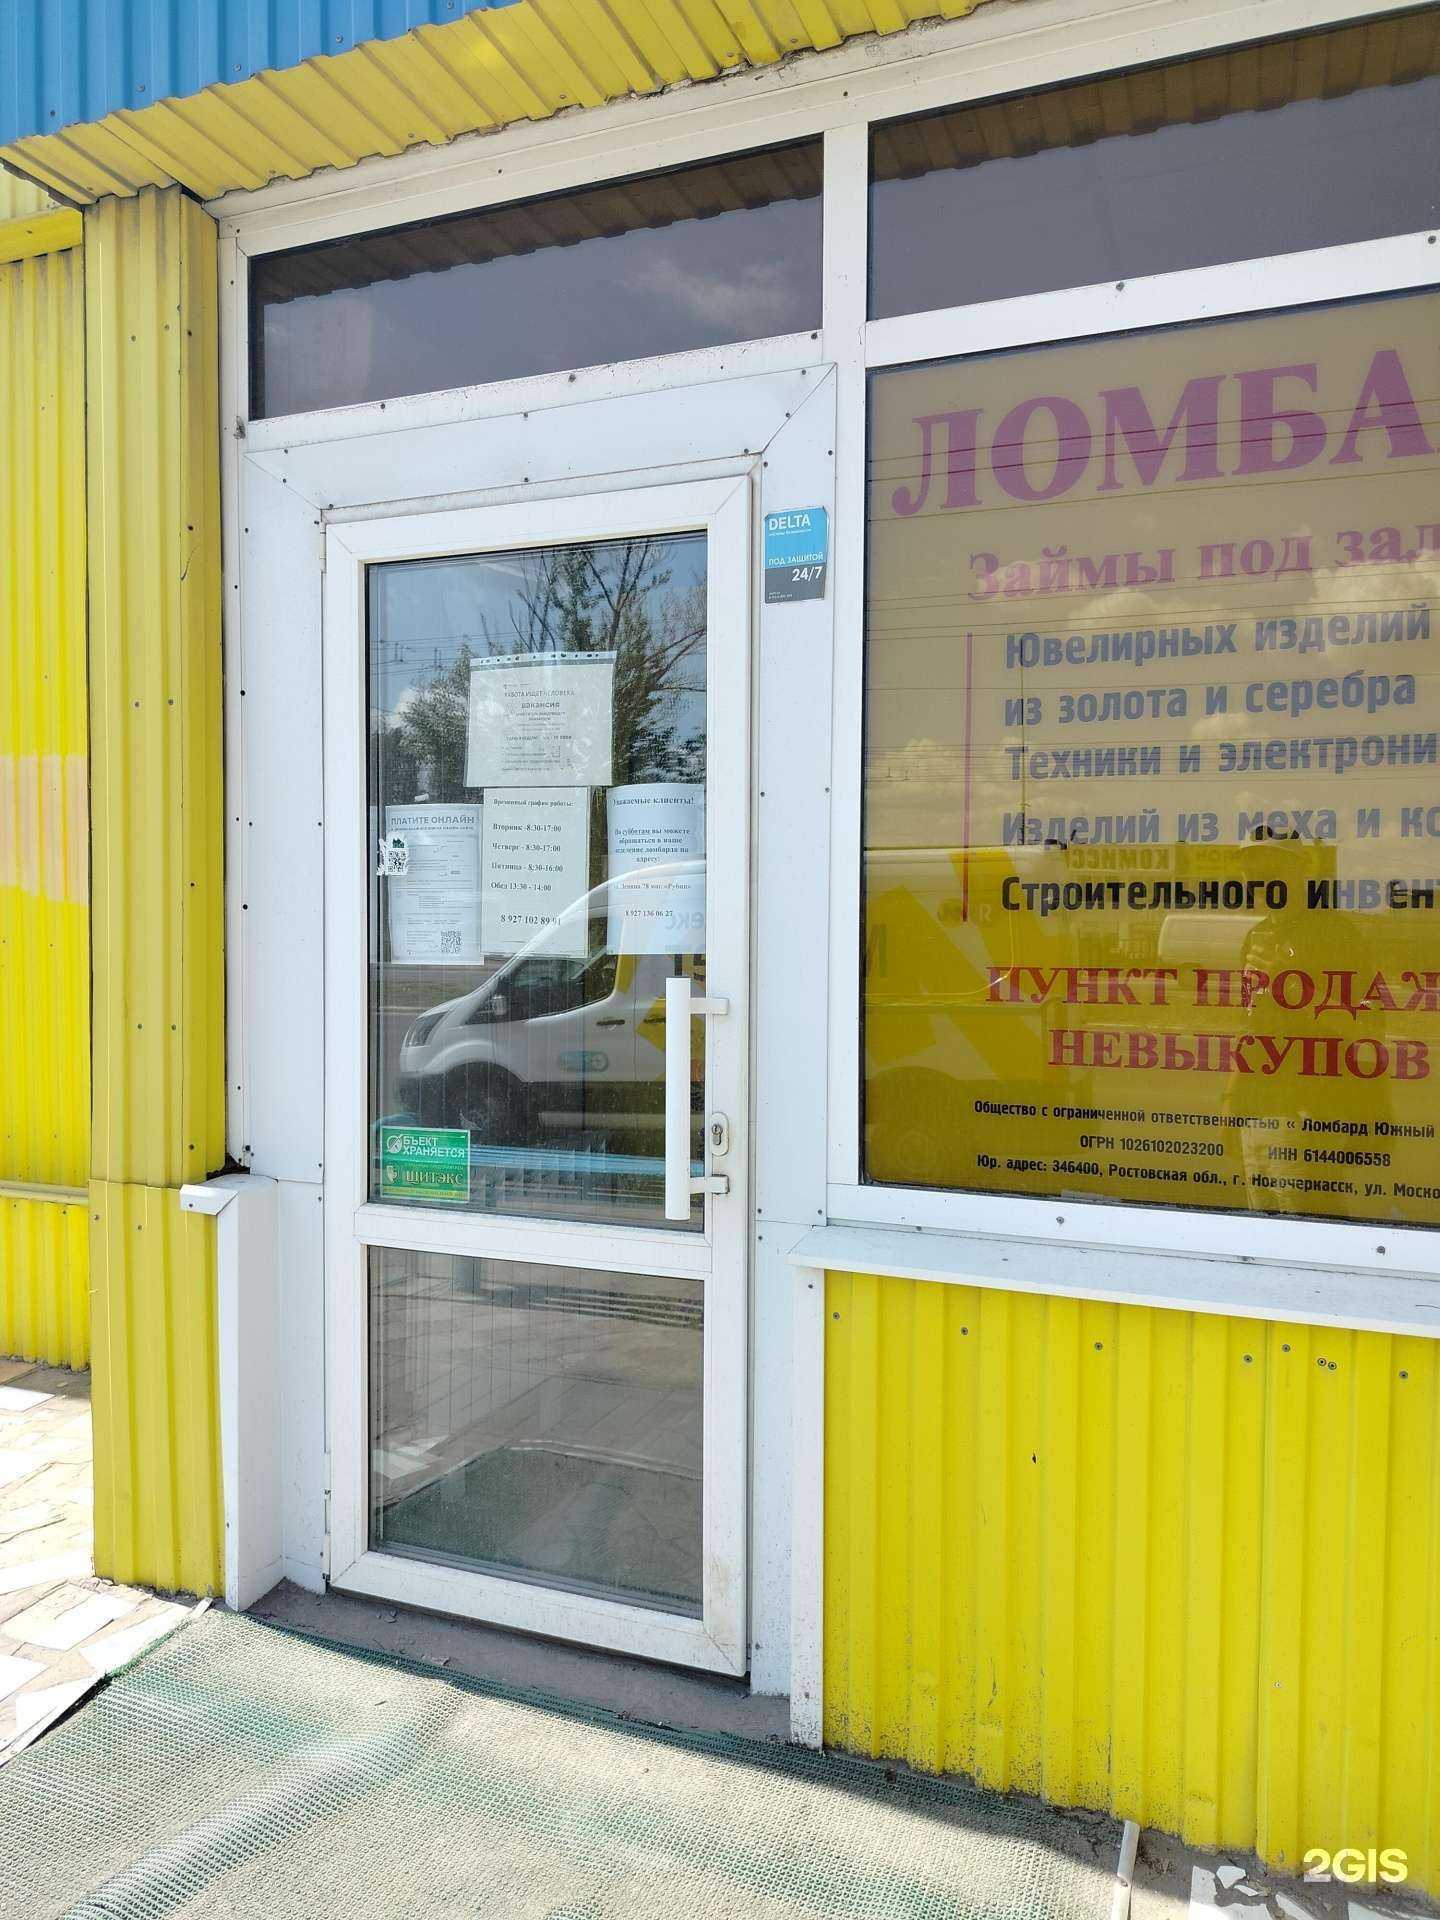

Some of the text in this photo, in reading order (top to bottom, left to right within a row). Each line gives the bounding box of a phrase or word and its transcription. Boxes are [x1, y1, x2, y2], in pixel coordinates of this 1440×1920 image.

[891, 350, 1440, 516] ЛОМБА
[768, 513, 811, 530] DELTA
[768, 557, 786, 566] ПОД
[791, 566, 824, 582] 24/7
[968, 545, 1176, 600] Займы
[1197, 536, 1313, 581] под
[1006, 603, 1431, 668] Ювелирных изделий
[1004, 669, 1416, 727] из золота и серебра
[1005, 743, 1160, 780] Техники
[1179, 745, 1200, 773] и
[391, 814, 474, 825] ПЛАТИТЕ ОНЛАЙН
[1002, 809, 1159, 845] Изделий
[1178, 813, 1219, 843] из
[1238, 810, 1337, 841] меха
[1357, 810, 1379, 839] и
[1001, 876, 1287, 917] Строительного
[1308, 878, 1440, 911] инвен
[500, 914, 506, 922] 8
[508, 914, 522, 923] 927
[524, 915, 538, 925] 102
[985, 966, 1178, 1007] ПУНКТ
[1048, 1029, 1430, 1081] НЕВЫКУПОВ
[974, 1101, 1036, 1117] Общество
[1042, 1106, 1048, 1116] с
[1053, 1105, 1145, 1122] ограниченной
[1151, 1111, 1279, 1130] ответственностью
[1301, 1119, 1368, 1137] Ломбард
[1374, 1120, 1435, 1138] Южный
[1080, 1135, 1391, 1167] ОГРН 1026102023200 ИНН 6144006558
[406, 1171, 463, 1185] ЩИТЭКС
[977, 1155, 1001, 1169] Юр.
[1006, 1157, 1047, 1172] адрес:
[1108, 1164, 1187, 1183] Ростовская
[1193, 1170, 1227, 1185] обл.,
[1232, 1174, 1246, 1186] г.
[1251, 1174, 1358, 1195] Новочеркасск,
[1364, 1184, 1387, 1197] ул.
